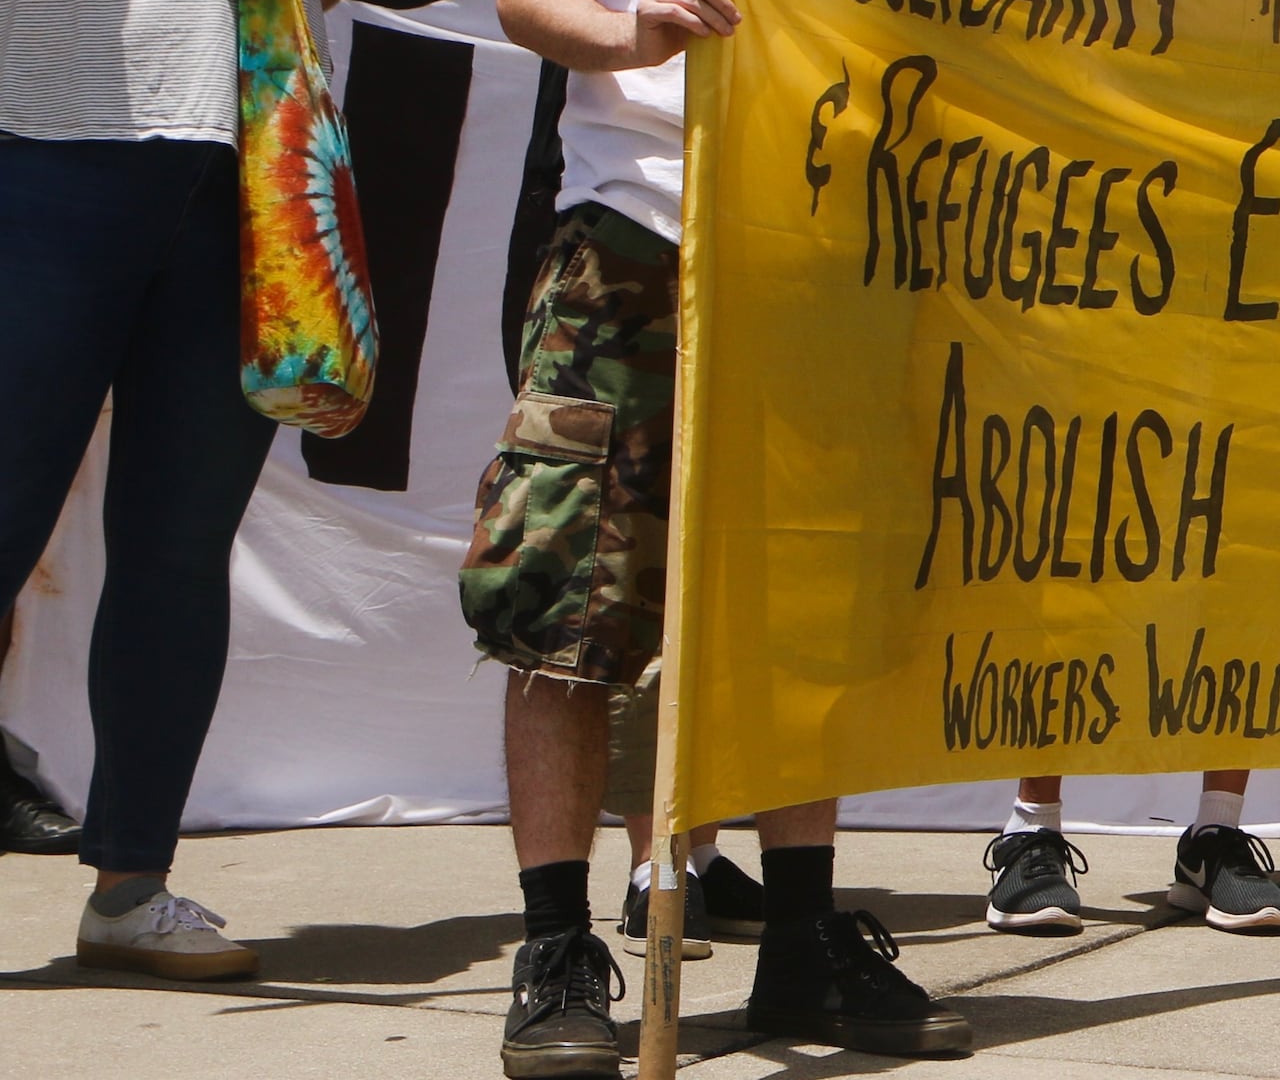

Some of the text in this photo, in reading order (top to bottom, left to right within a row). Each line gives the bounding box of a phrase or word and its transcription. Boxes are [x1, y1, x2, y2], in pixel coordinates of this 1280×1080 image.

[863, 54, 1179, 317] REFUGEES
[914, 342, 1236, 592] ABOLISH
[942, 630, 1121, 752] WORKERS
